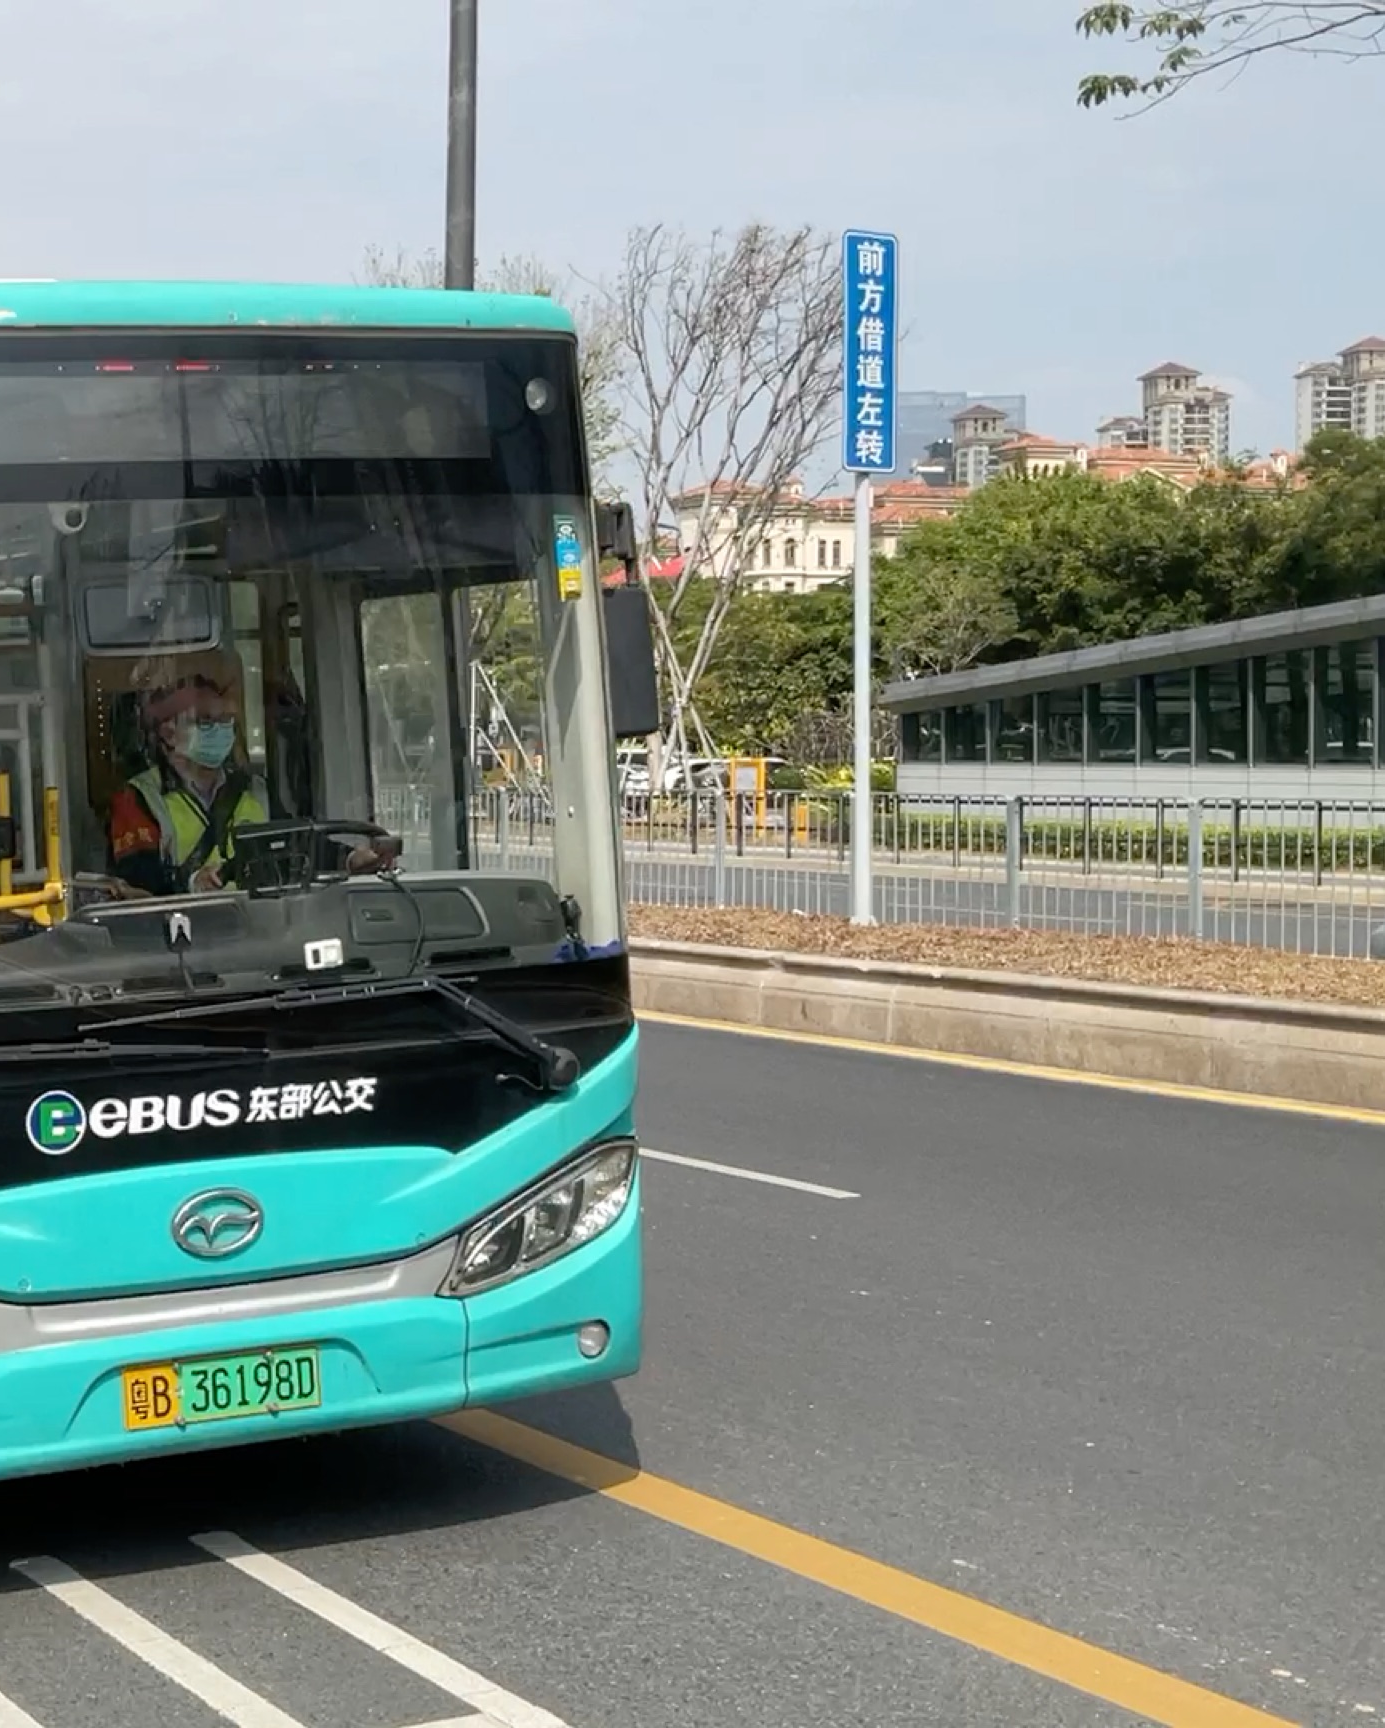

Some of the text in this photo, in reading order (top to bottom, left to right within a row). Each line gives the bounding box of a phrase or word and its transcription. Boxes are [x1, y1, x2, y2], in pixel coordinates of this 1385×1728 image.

[855, 241, 886, 464] 前方借道左转
[246, 1077, 378, 1123] 东部公交
